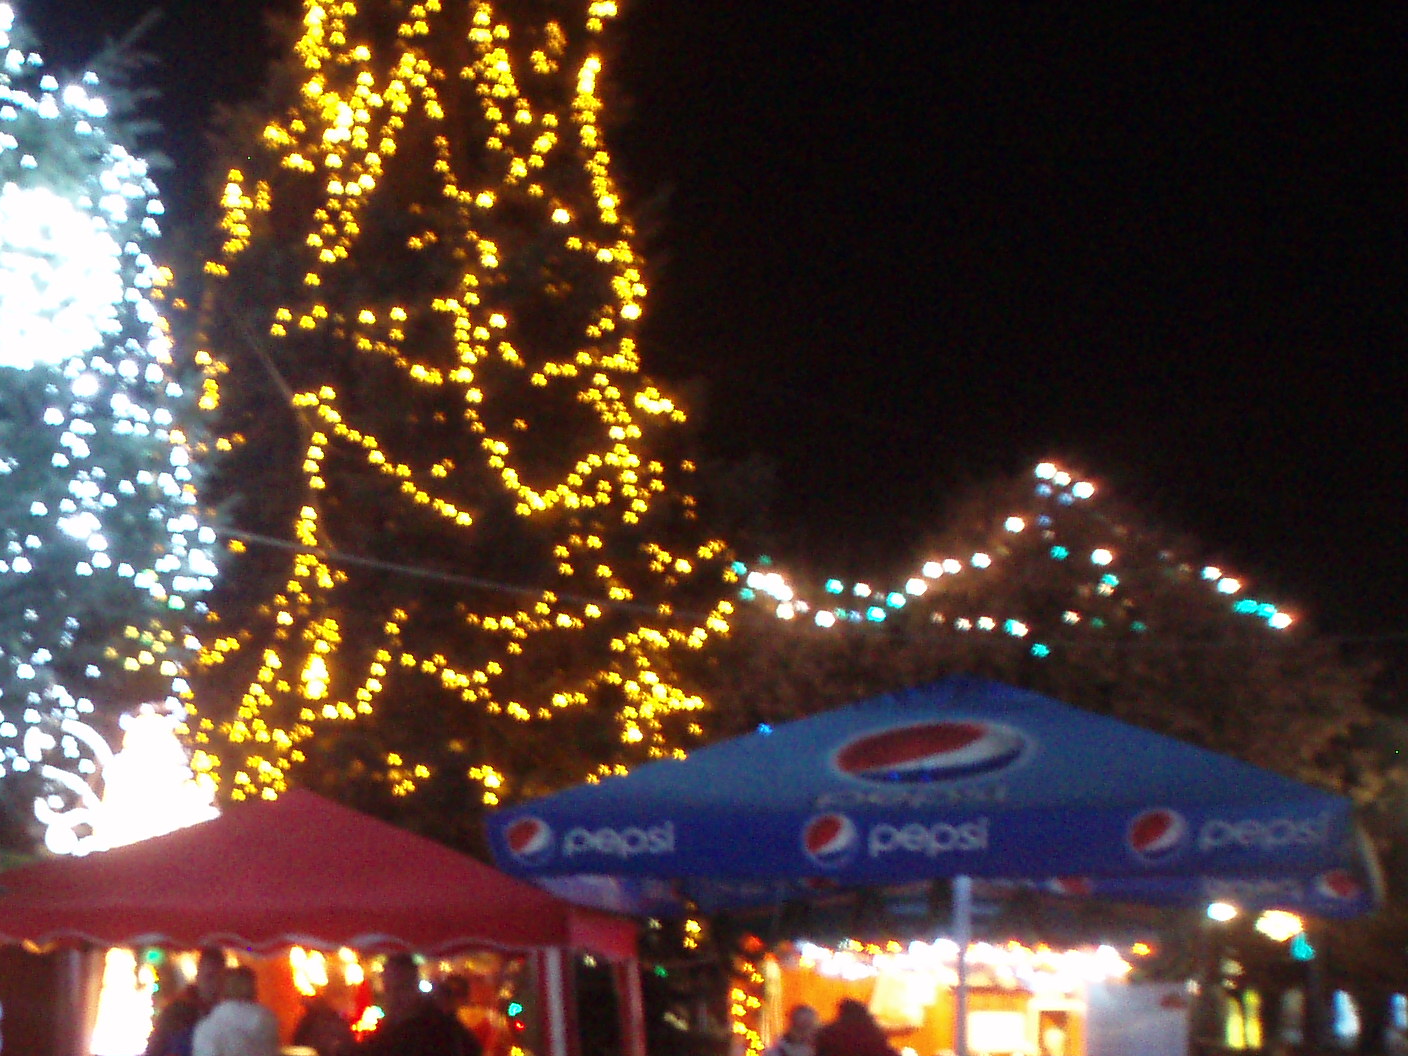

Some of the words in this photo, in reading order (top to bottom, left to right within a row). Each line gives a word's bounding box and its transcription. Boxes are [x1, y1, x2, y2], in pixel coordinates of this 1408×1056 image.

[563, 820, 675, 858] pepsi
[868, 814, 989, 856] pepsi
[1198, 811, 1332, 850] pepsi
